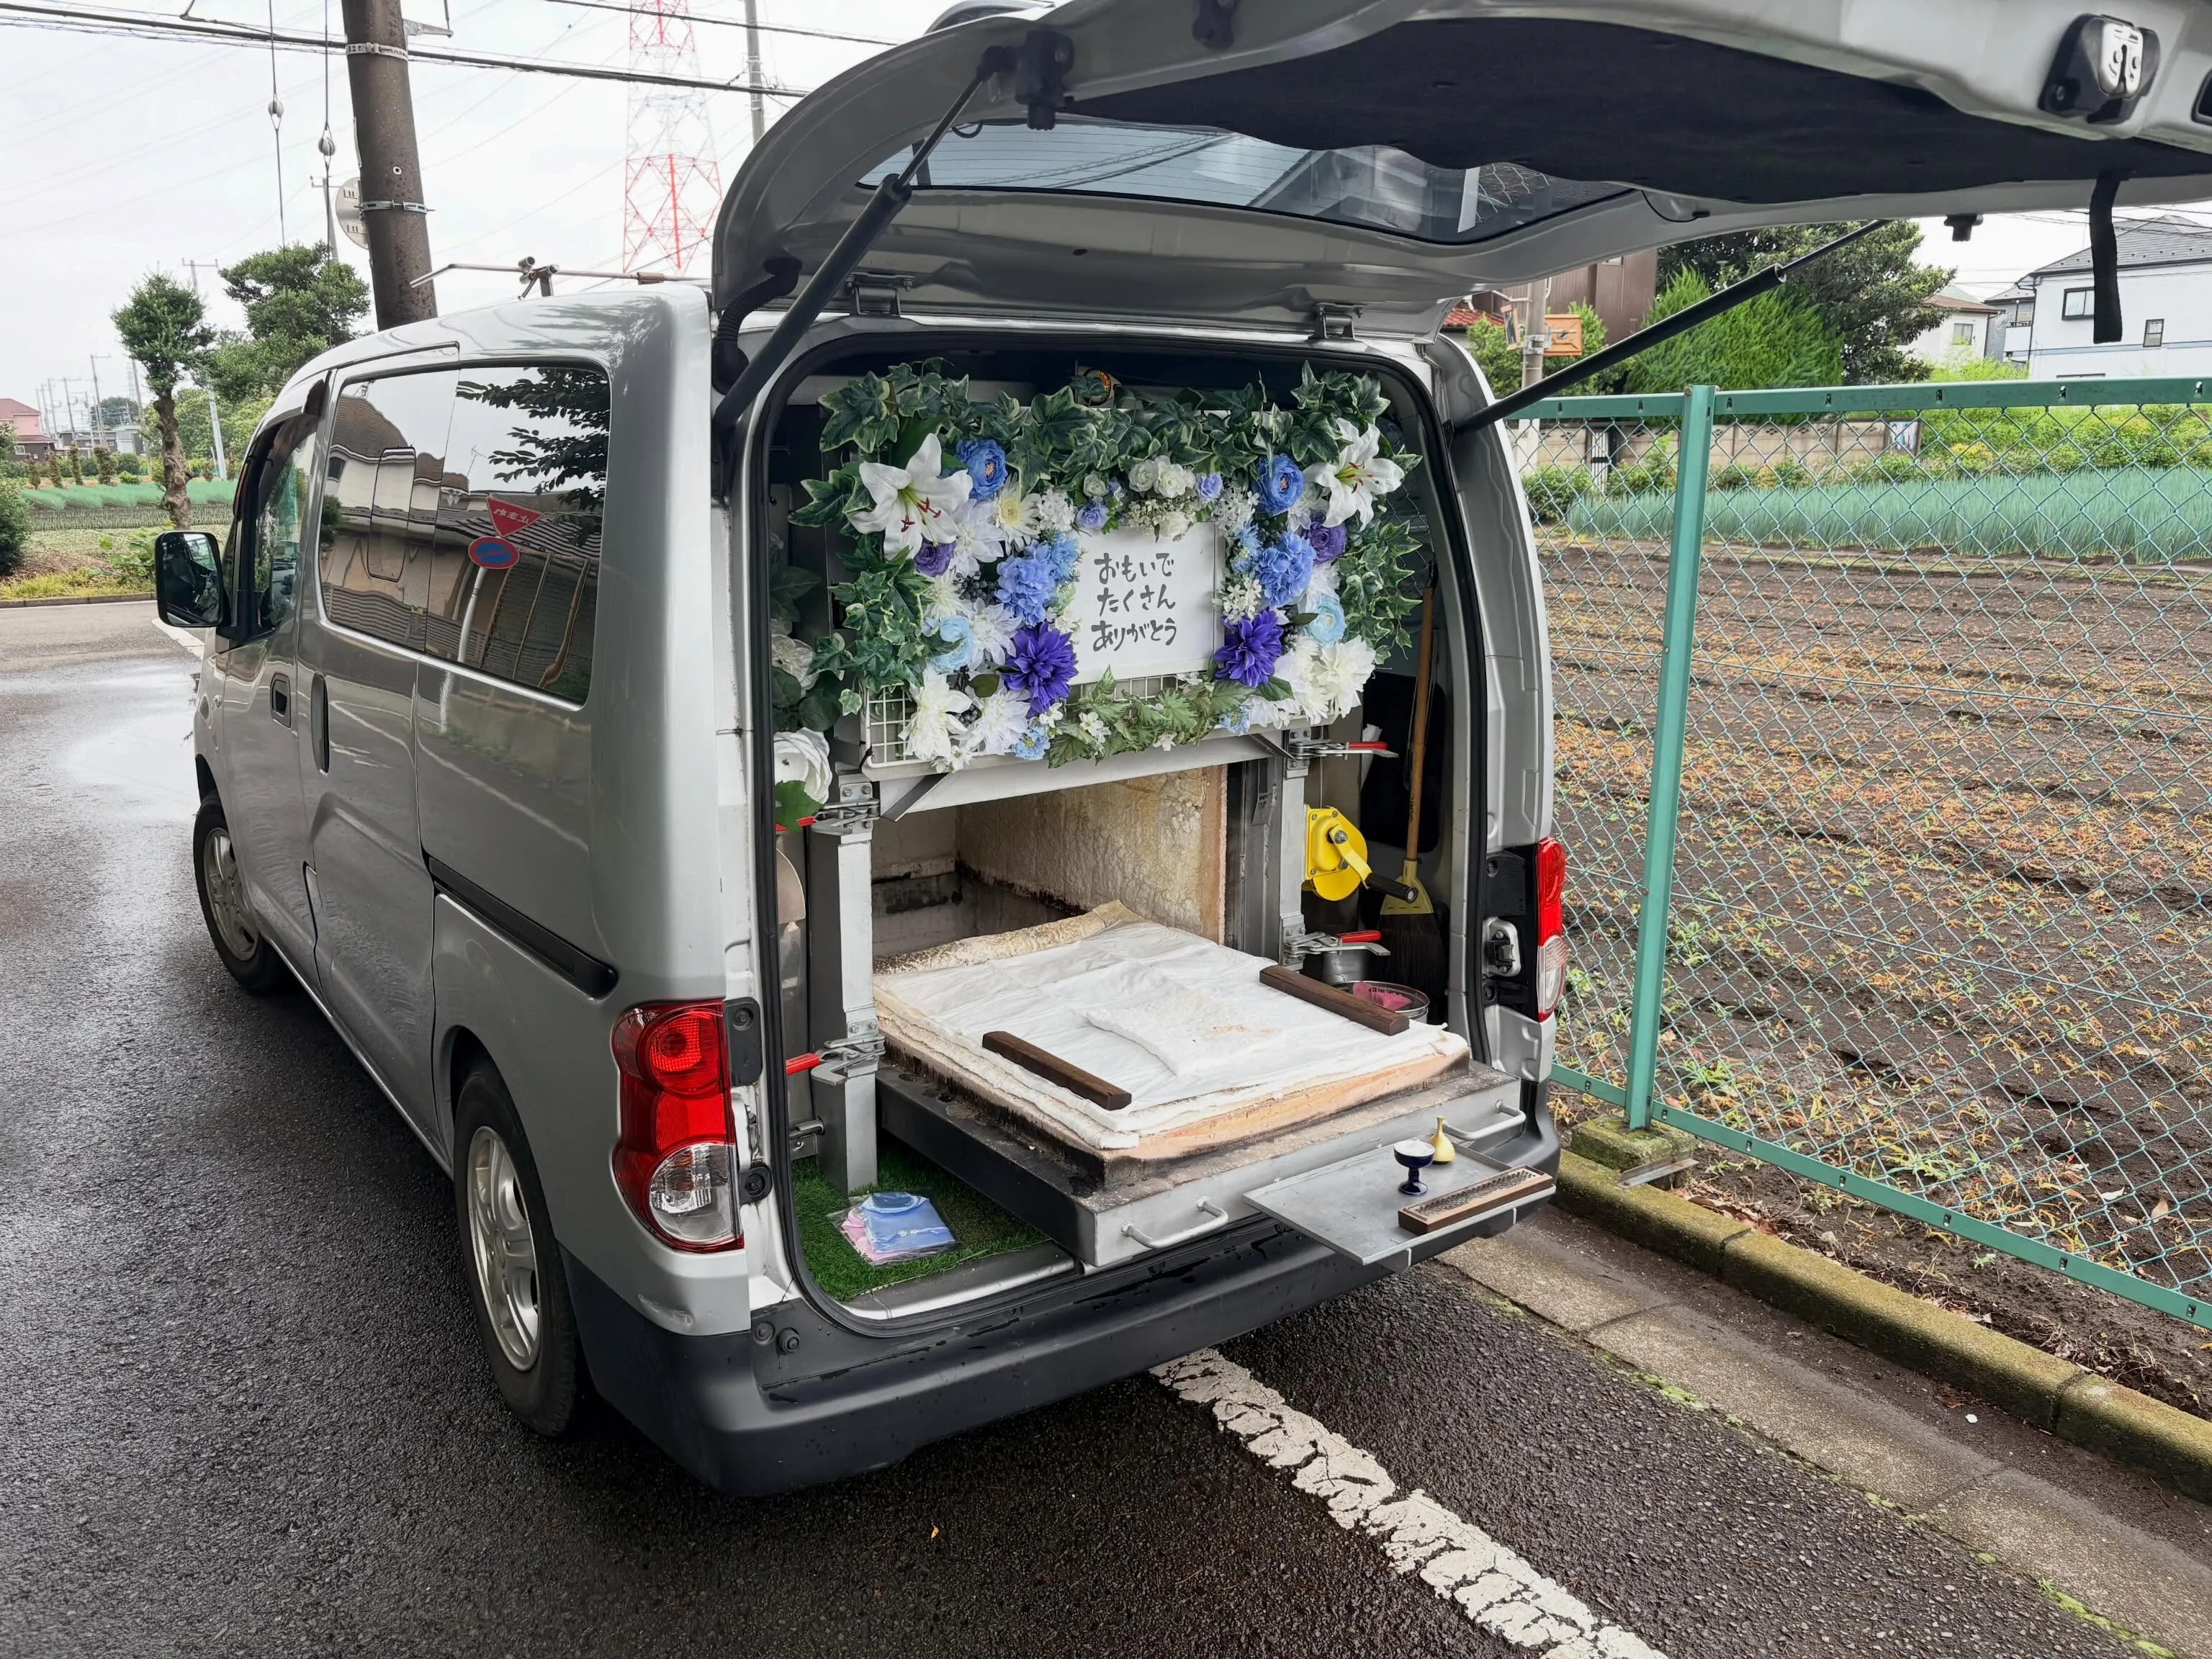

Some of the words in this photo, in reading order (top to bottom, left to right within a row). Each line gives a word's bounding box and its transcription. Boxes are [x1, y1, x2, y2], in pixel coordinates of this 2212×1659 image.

[1094, 552, 1174, 585] おもいで
[1097, 584, 1176, 617] たくさん
[1091, 617, 1177, 652] ありがとう
